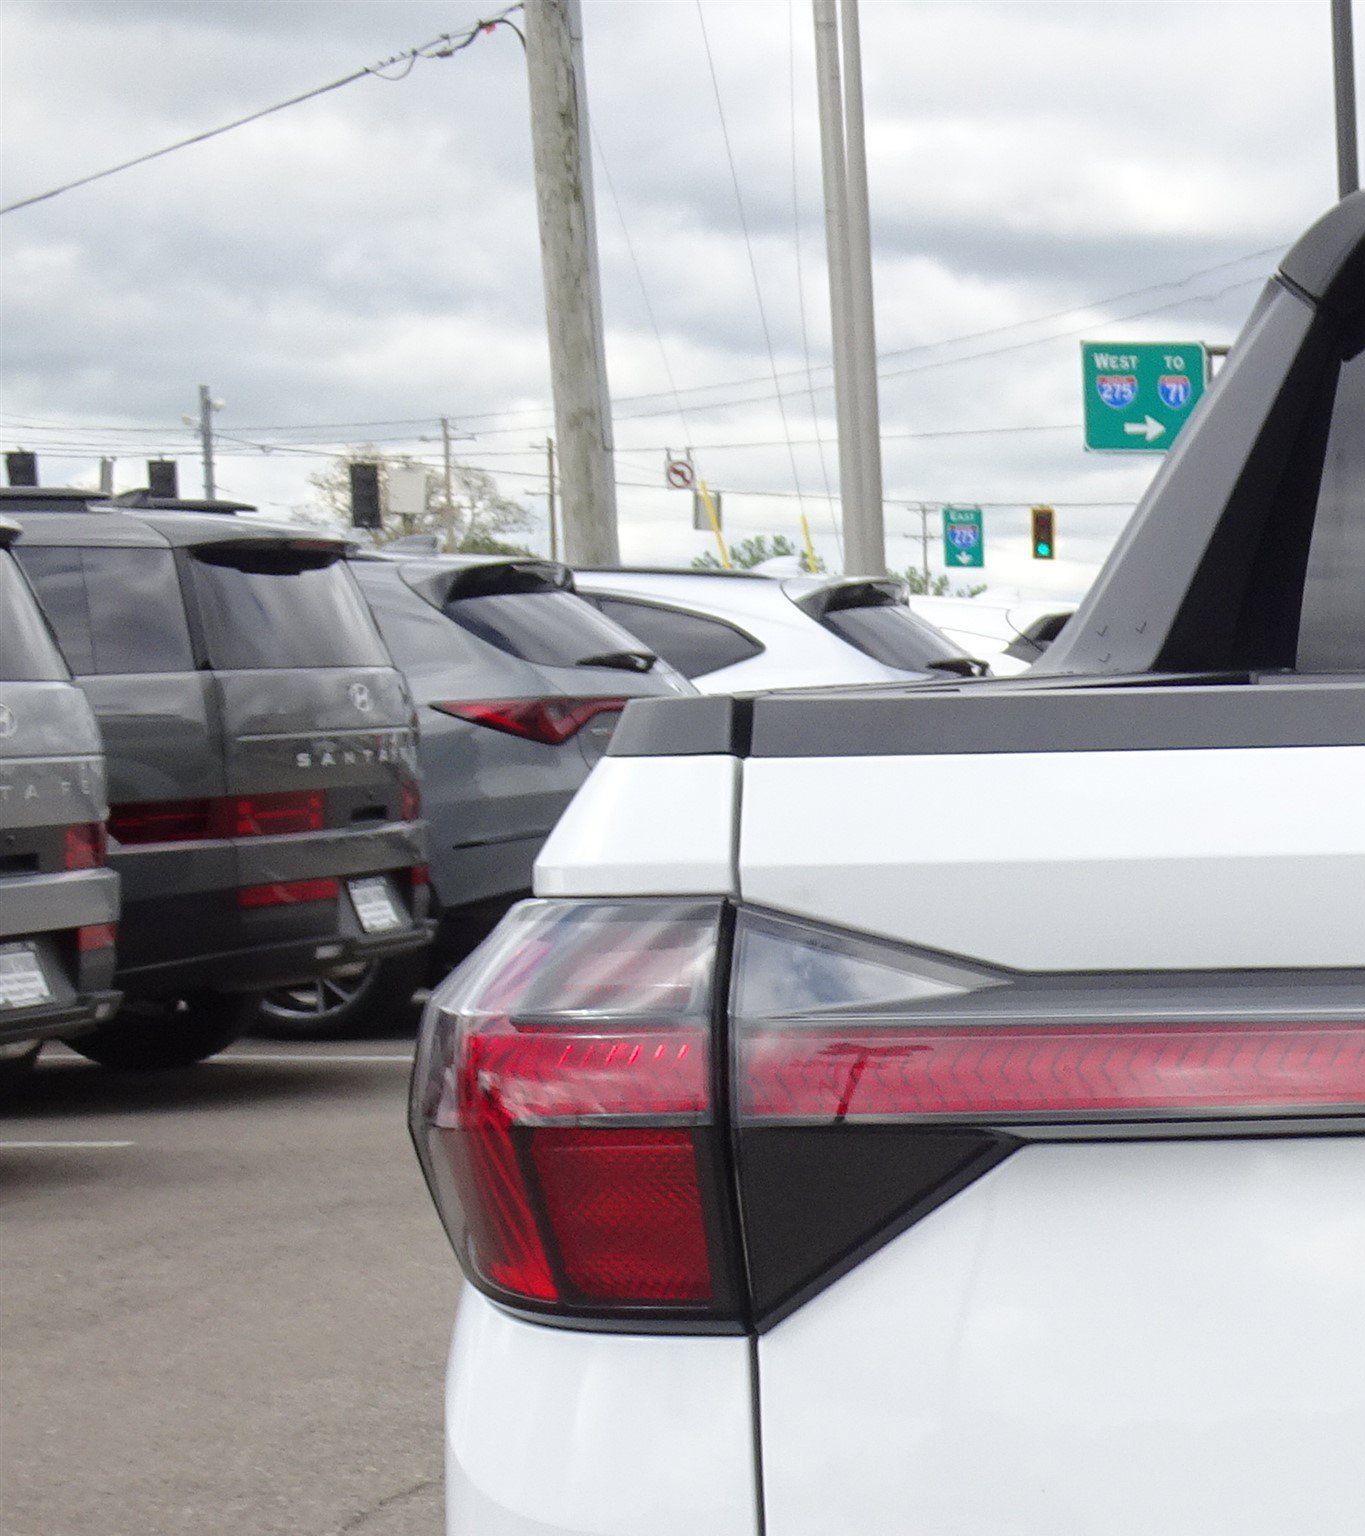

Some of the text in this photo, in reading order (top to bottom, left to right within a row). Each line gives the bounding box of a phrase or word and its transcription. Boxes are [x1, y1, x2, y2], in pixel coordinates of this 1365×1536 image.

[1093, 353, 1186, 371] WEST TO
[1102, 383, 1185, 402] 275 71
[296, 749, 389, 768] SANTA
